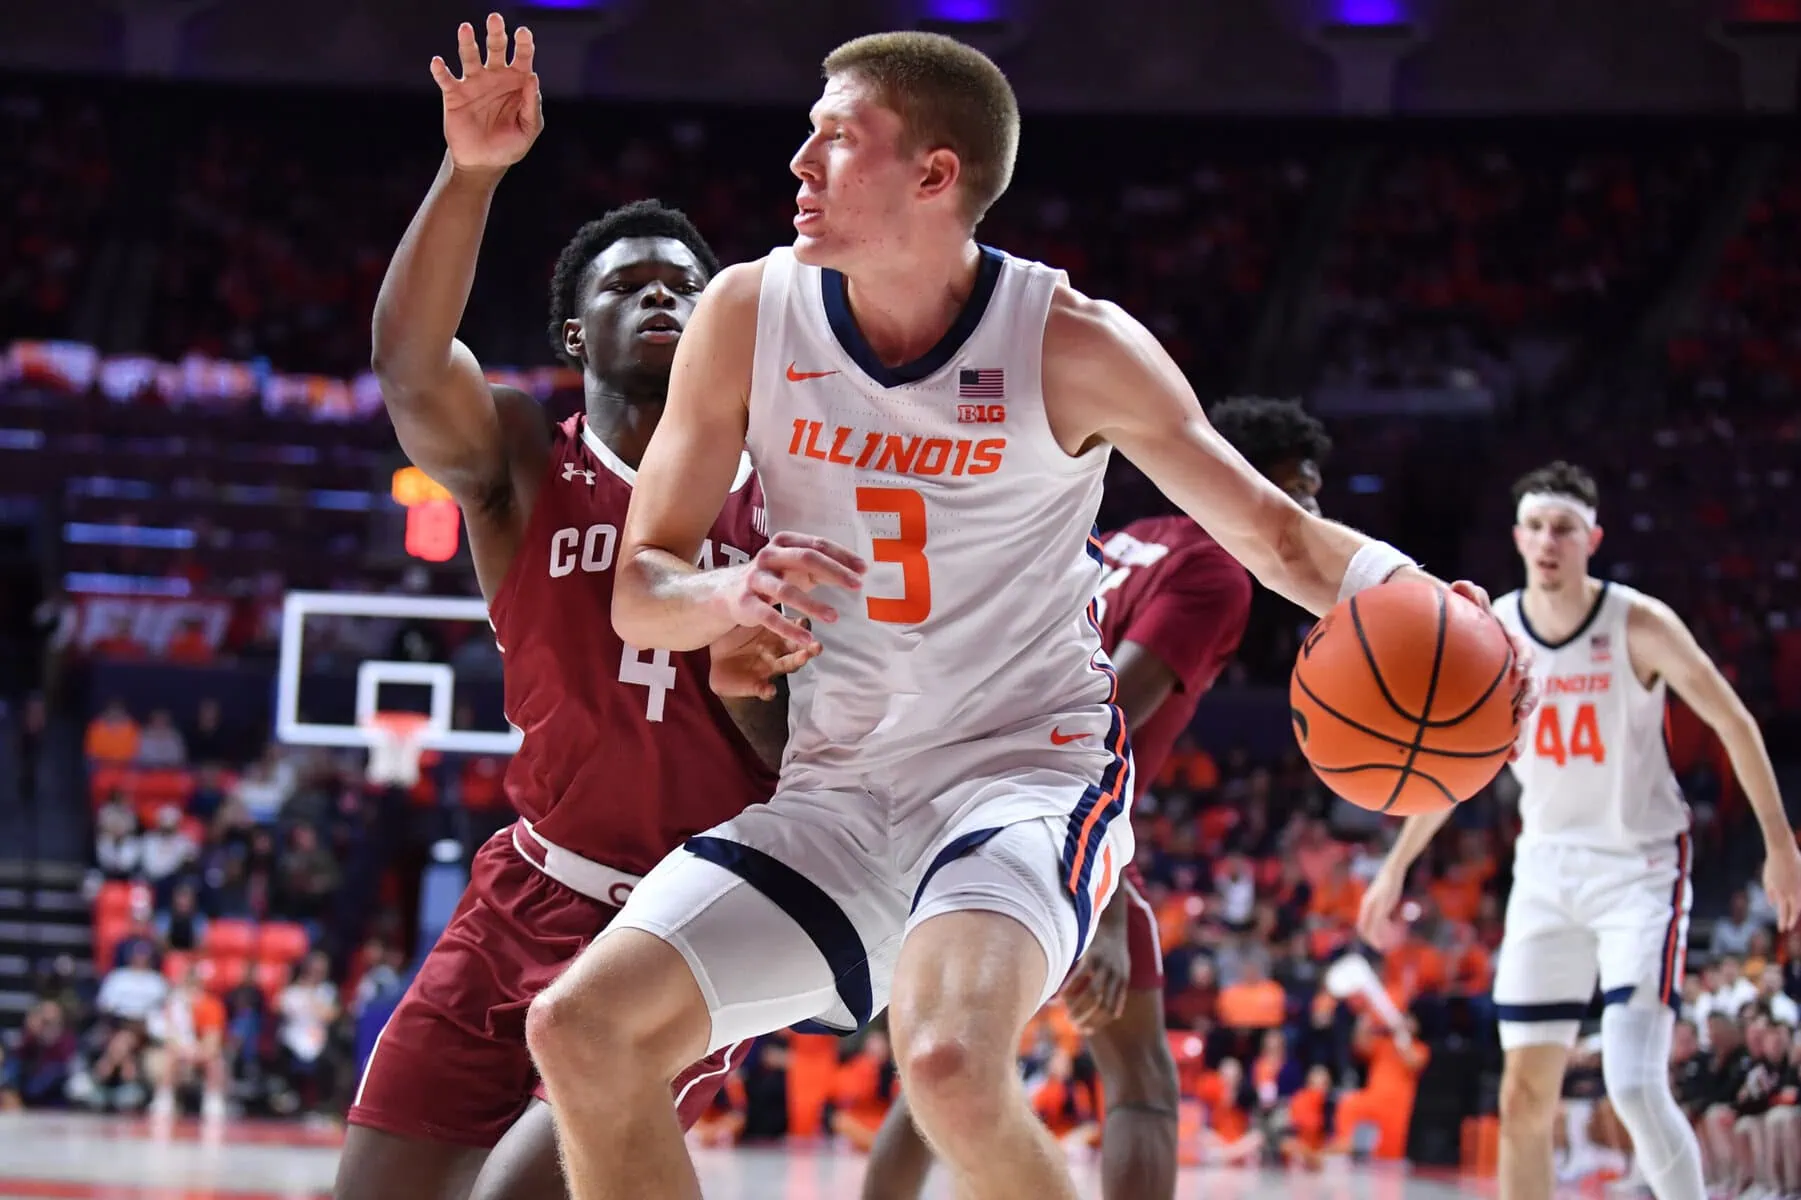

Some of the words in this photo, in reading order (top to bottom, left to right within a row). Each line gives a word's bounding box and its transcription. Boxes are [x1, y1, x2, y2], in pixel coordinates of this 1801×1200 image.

[788, 418, 1006, 476] ILLINOIS
[855, 486, 932, 624] 3
[618, 640, 677, 722] 4
[1535, 702, 1606, 768] 44
